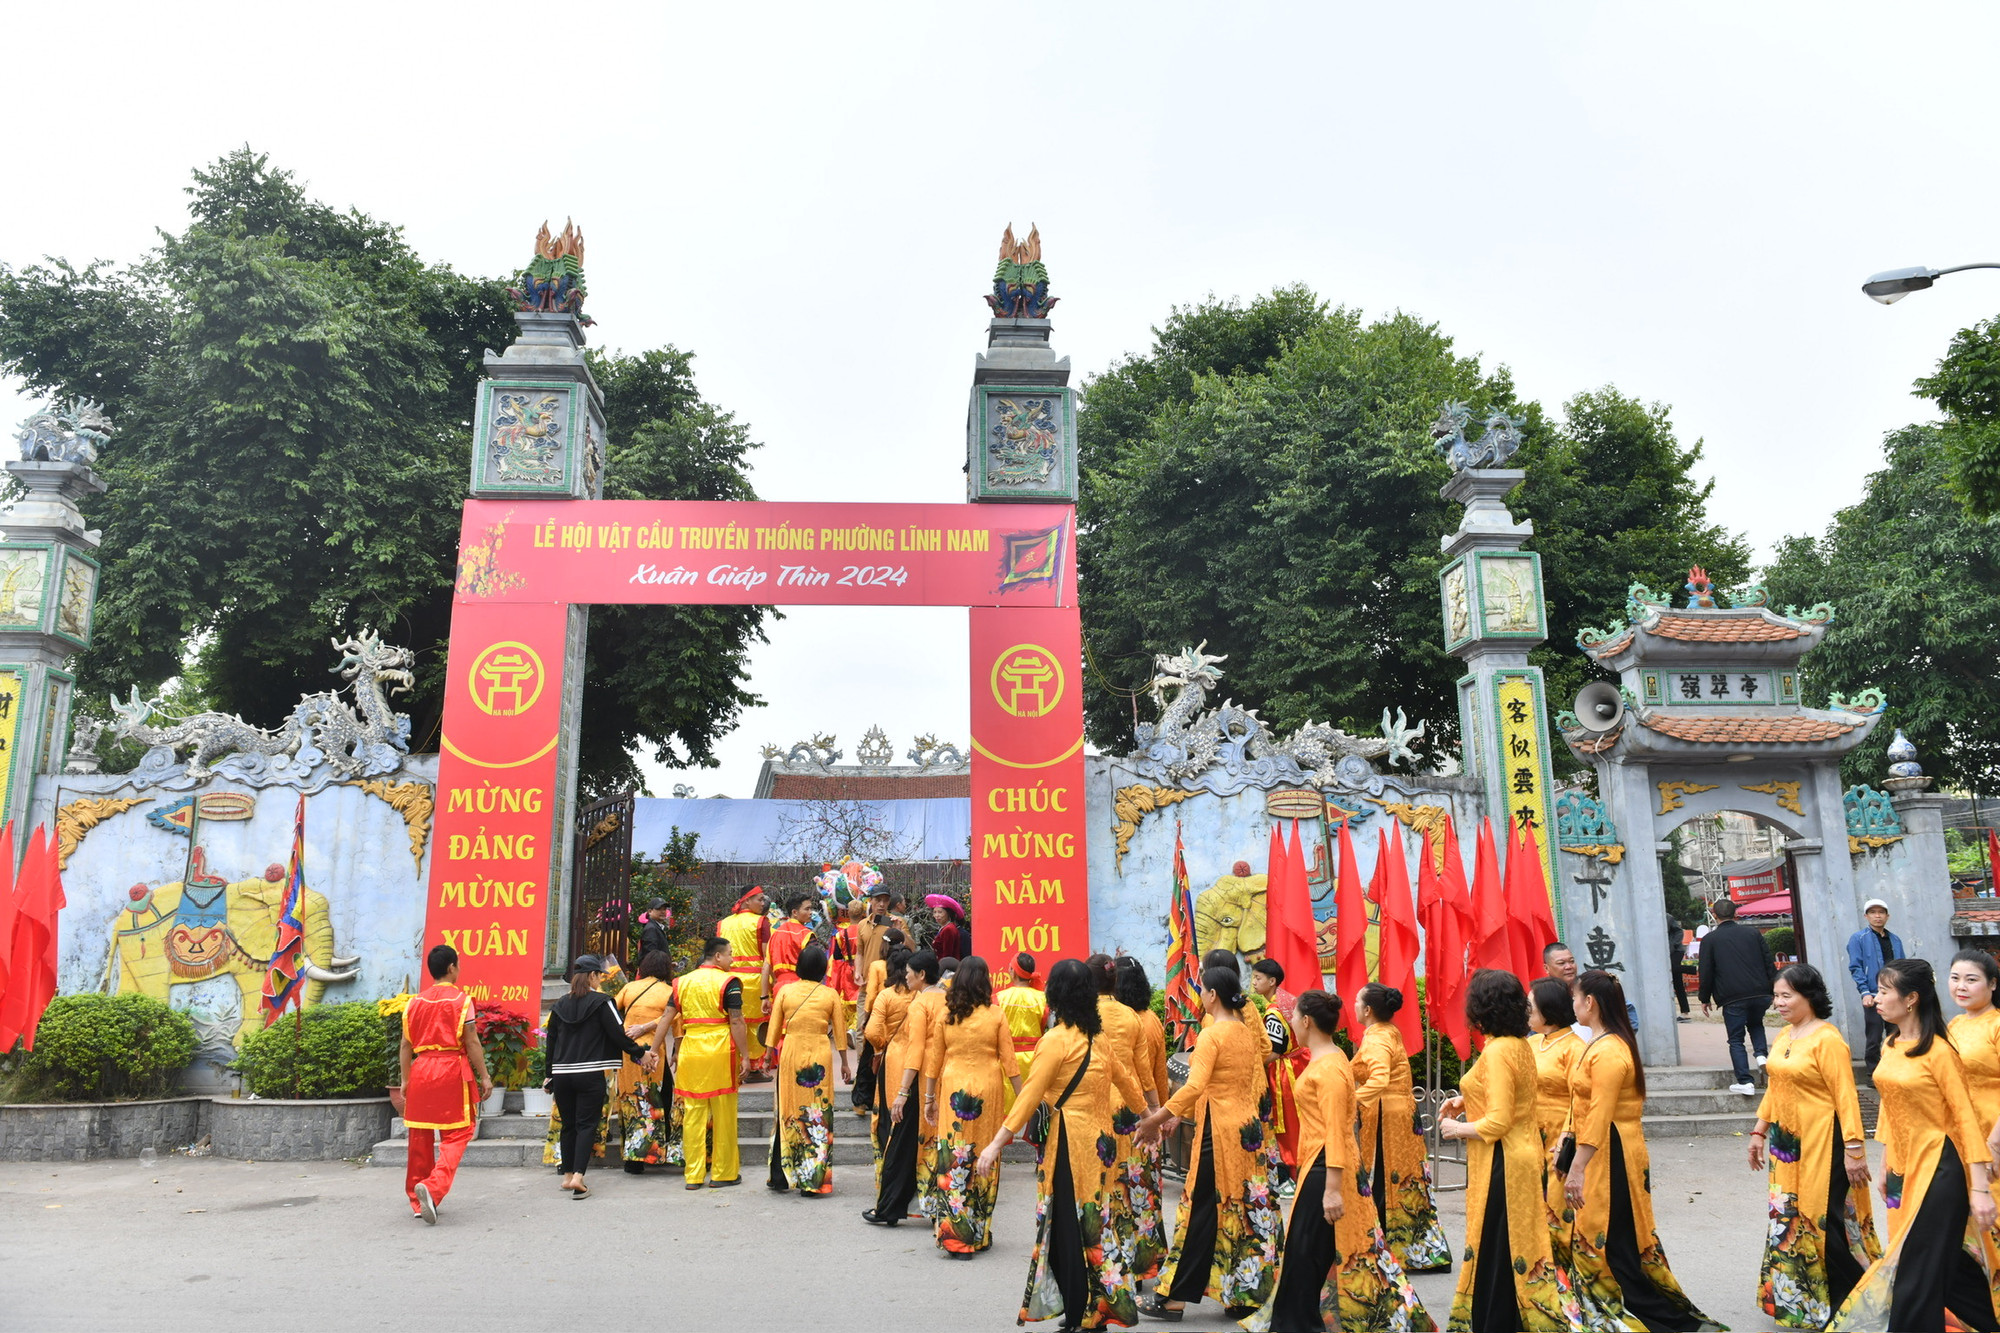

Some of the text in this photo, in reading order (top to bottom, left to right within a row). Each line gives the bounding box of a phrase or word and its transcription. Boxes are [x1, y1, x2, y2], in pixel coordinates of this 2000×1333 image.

[534, 517, 989, 553] LỄ HỘI VẬT CẦU TRUYỀN THỐNG PHƯỜNG LĨNH NAM
[629, 563, 908, 592] Xuân Giáp Thìn 2024
[447, 780, 542, 813] MỪNG
[988, 780, 1068, 812] CHÚC
[448, 826, 535, 860] ĐẢNG
[983, 826, 1074, 858] MỪNG
[439, 874, 536, 908] MỪNG
[995, 873, 1065, 904] NĂM
[441, 922, 528, 956] XUÂN
[1001, 918, 1060, 952] MỚI
[1574, 875, 1625, 972] 下車
[501, 985, 529, 1002] 2024
[989, 967, 1011, 989] IÁP
